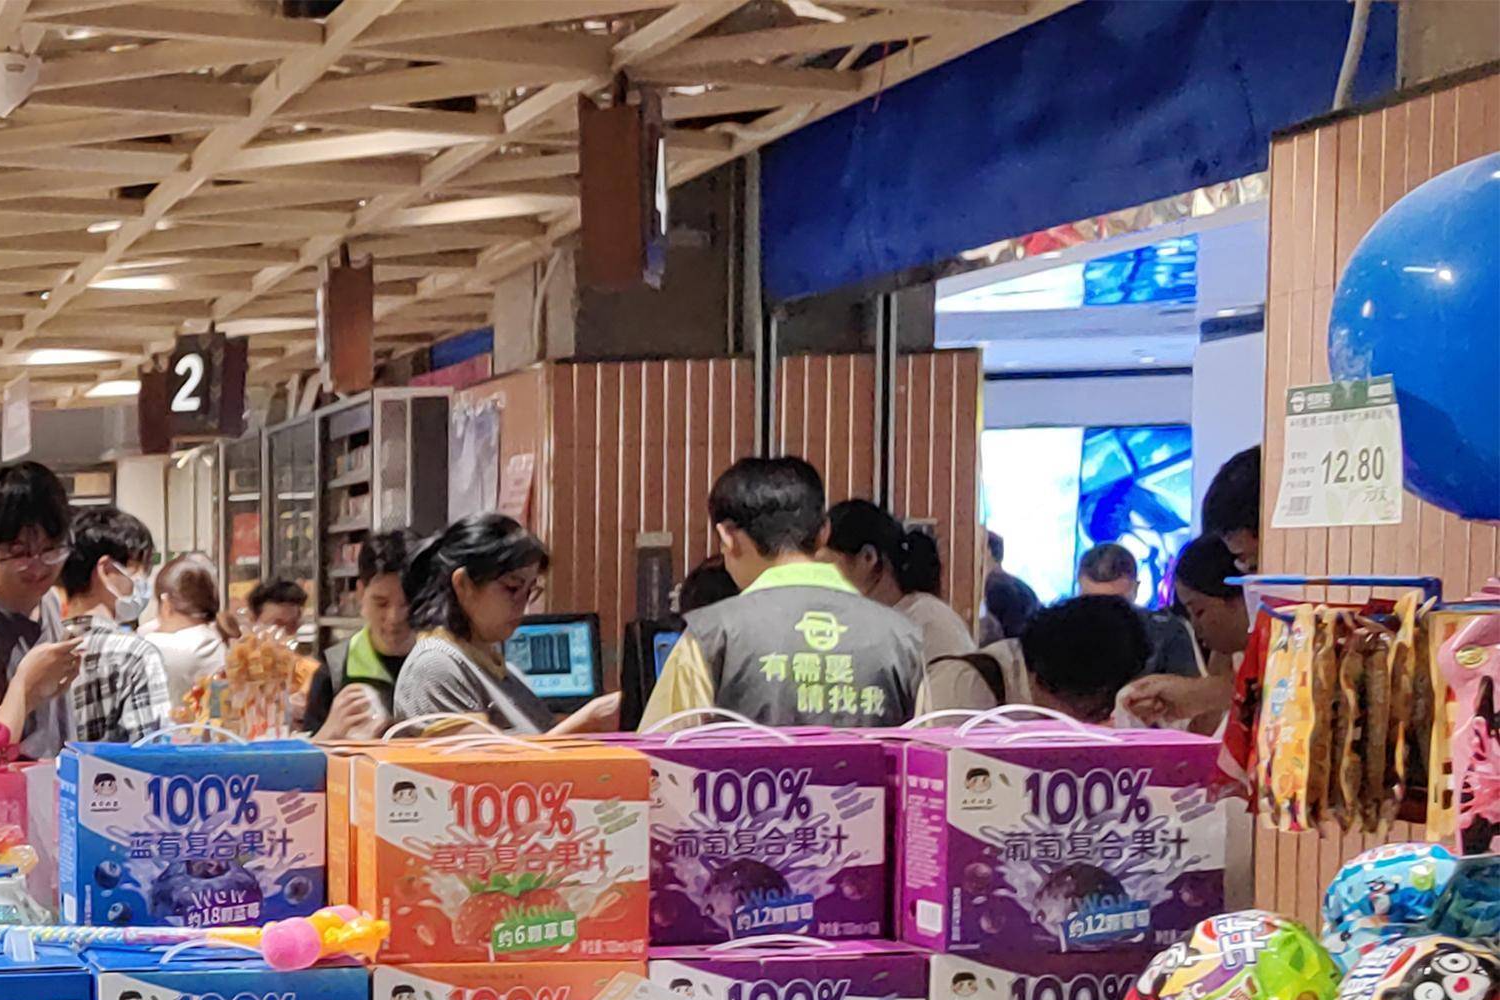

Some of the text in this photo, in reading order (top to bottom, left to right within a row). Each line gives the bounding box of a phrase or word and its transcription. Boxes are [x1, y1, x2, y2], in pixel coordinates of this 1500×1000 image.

[171, 352, 204, 412] 2
[1321, 446, 1385, 485] 12.80
[759, 652, 854, 683] 有需要
[147, 774, 259, 826] 100%
[449, 781, 576, 838] 100%
[692, 767, 813, 822] 100%
[1025, 767, 1154, 825] 100%
[129, 827, 294, 860] 蓝莓复合果汁
[673, 824, 849, 858] 葡萄复合果汁
[1001, 827, 1189, 862] 葡萄复合果汁
